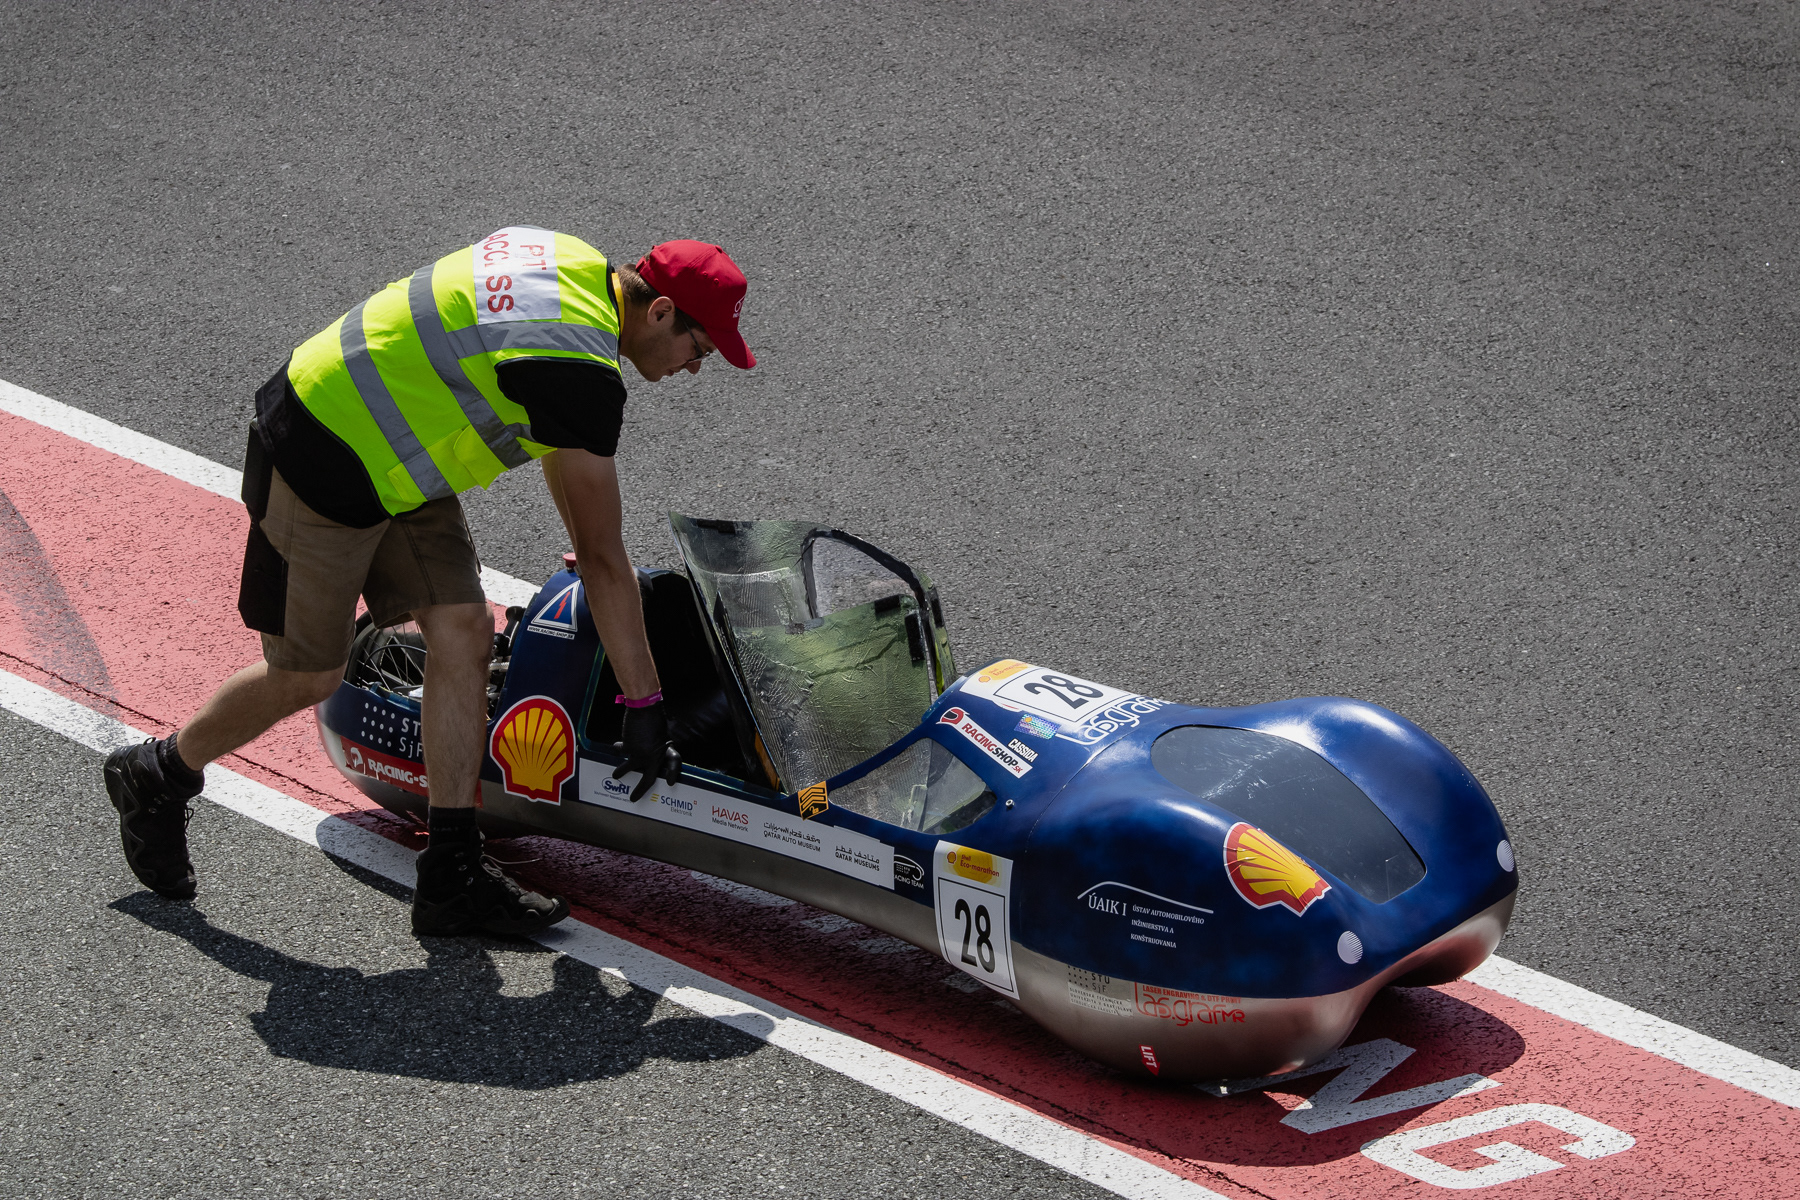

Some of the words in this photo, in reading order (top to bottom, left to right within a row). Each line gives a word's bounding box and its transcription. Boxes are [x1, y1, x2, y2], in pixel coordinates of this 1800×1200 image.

[483, 233, 515, 313] ACCSS
[1023, 674, 1104, 710] 28
[401, 717, 421, 737] ST
[1007, 738, 1039, 763] CASSIDA
[367, 757, 428, 788] RACING-S
[604, 780, 631, 795] SwRI
[660, 795, 693, 811] SCHMID
[670, 806, 693, 817] Elektronik
[711, 805, 749, 825] HAVAS
[711, 817, 727, 828] Media
[727, 822, 749, 833] Network
[763, 830, 781, 841] QATAR
[781, 835, 797, 845] AUTO
[797, 840, 821, 852] MUSEUM
[835, 851, 853, 863] QATAR
[853, 857, 880, 872] MUSEUMS
[961, 853, 972, 862] Shell
[959, 859, 1000, 878] Eco-marathon
[911, 879, 925, 890] TEAM
[1088, 892, 1120, 915] ÚAIK
[1132, 903, 1151, 915] ÚSTAV
[1150, 908, 1205, 925] AUTOMOBILOVÉHO
[1131, 919, 1169, 933] INŽINIERSTVA
[954, 898, 996, 974] 28
[1130, 932, 1177, 949] KONŠTRUOVANIA
[1091, 972, 1110, 985] STU
[1092, 982, 1107, 994] SjF
[1142, 984, 1162, 995] LASER
[1162, 988, 1200, 1001] ENGRAVING
[1140, 1045, 1158, 1069] LIFT
